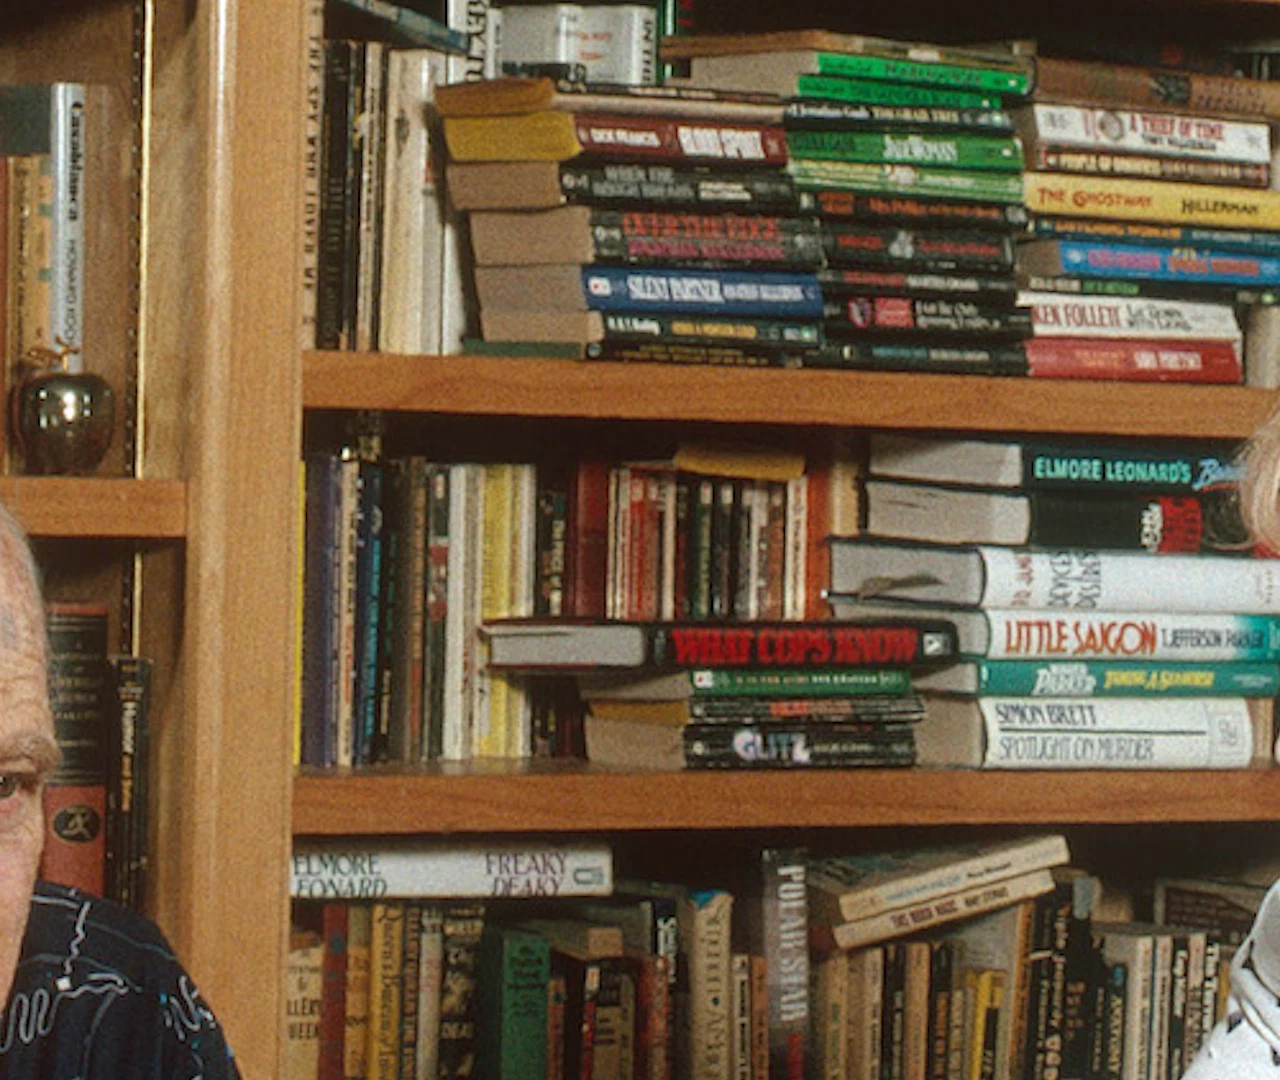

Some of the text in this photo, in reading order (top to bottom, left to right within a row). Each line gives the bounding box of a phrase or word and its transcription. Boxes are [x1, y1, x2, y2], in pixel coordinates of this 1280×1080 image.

[1128, 114, 1224, 142] A THIEF OF TIME
[66, 101, 85, 304] Casablanca HOWARD
[1037, 188, 1259, 215] THE GHOSTWAY HILLERMAN
[1034, 304, 1060, 326] KEN
[1064, 304, 1121, 328] FOLLETT
[1033, 456, 1192, 484] ELMORE LEONARD'S
[671, 626, 919, 664] WHAT COPS KNOW
[1005, 620, 1069, 654] LITTLE
[1072, 620, 1158, 656] SAIGON
[1225, 628, 1264, 648] PARKER
[1031, 667, 1097, 696] PARKER
[120, 701, 137, 755] Humor
[995, 703, 1097, 726] SIMON BRETT
[731, 729, 811, 763] GLITZ
[999, 736, 1155, 761] SPOTLIGHT ON MURDER
[293, 853, 382, 876] ELMORE
[485, 852, 569, 876] FREAKY
[490, 877, 565, 898] DEAKY
[776, 864, 809, 953] POLAR
[376, 905, 403, 971] Queen's
[1205, 943, 1221, 976] The
[380, 974, 401, 1032] Bureau
[777, 956, 809, 1023] STAR
[1107, 995, 1123, 1075] ANATOMY
